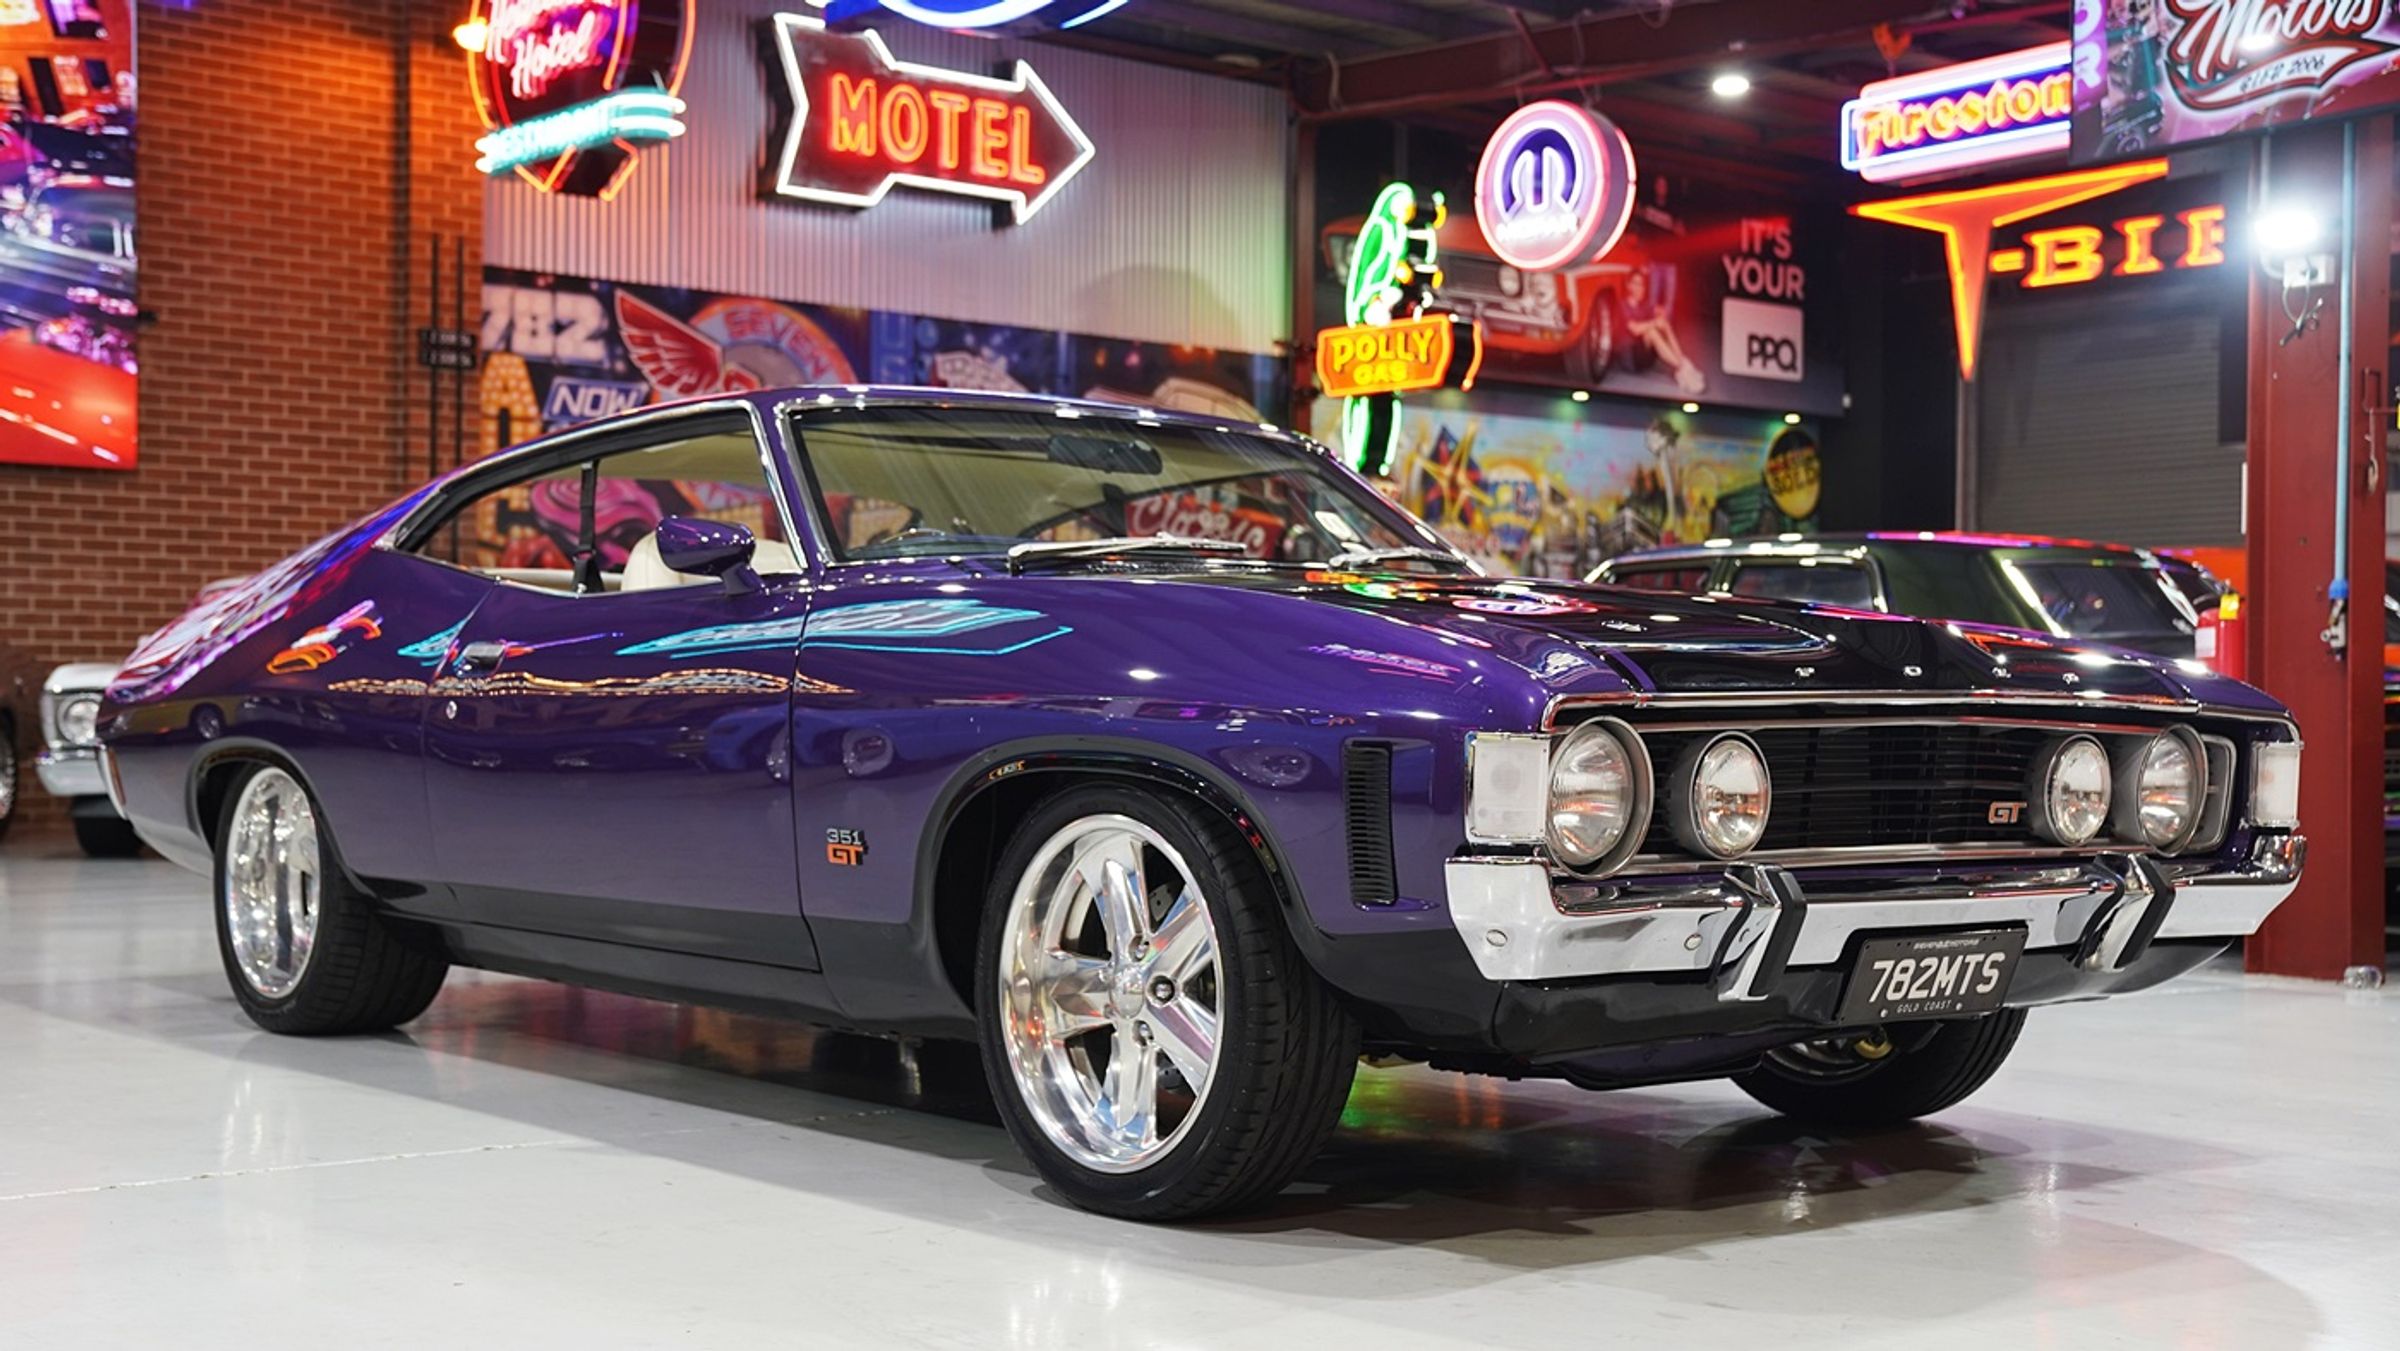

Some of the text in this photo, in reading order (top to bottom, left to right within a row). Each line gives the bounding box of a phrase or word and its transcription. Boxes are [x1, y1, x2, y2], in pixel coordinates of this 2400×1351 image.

[511, 10, 597, 98] Hotel
[2175, 0, 2373, 80] Motors
[827, 71, 1046, 185] MOTEL
[1741, 217, 1792, 260] IT'S
[1721, 254, 1805, 300] YOUR
[482, 284, 608, 363] 782
[1330, 328, 1435, 373] POLLY
[1747, 333, 1798, 373] PPQ
[1352, 359, 1409, 386] GAS
[552, 383, 638, 418] NOW
[1988, 801, 2028, 824] GT
[826, 827, 862, 845] 351
[826, 843, 864, 866] GT
[1868, 952, 2006, 1003] 782MTS
[1896, 1000, 1953, 1014] GOLD COAST
